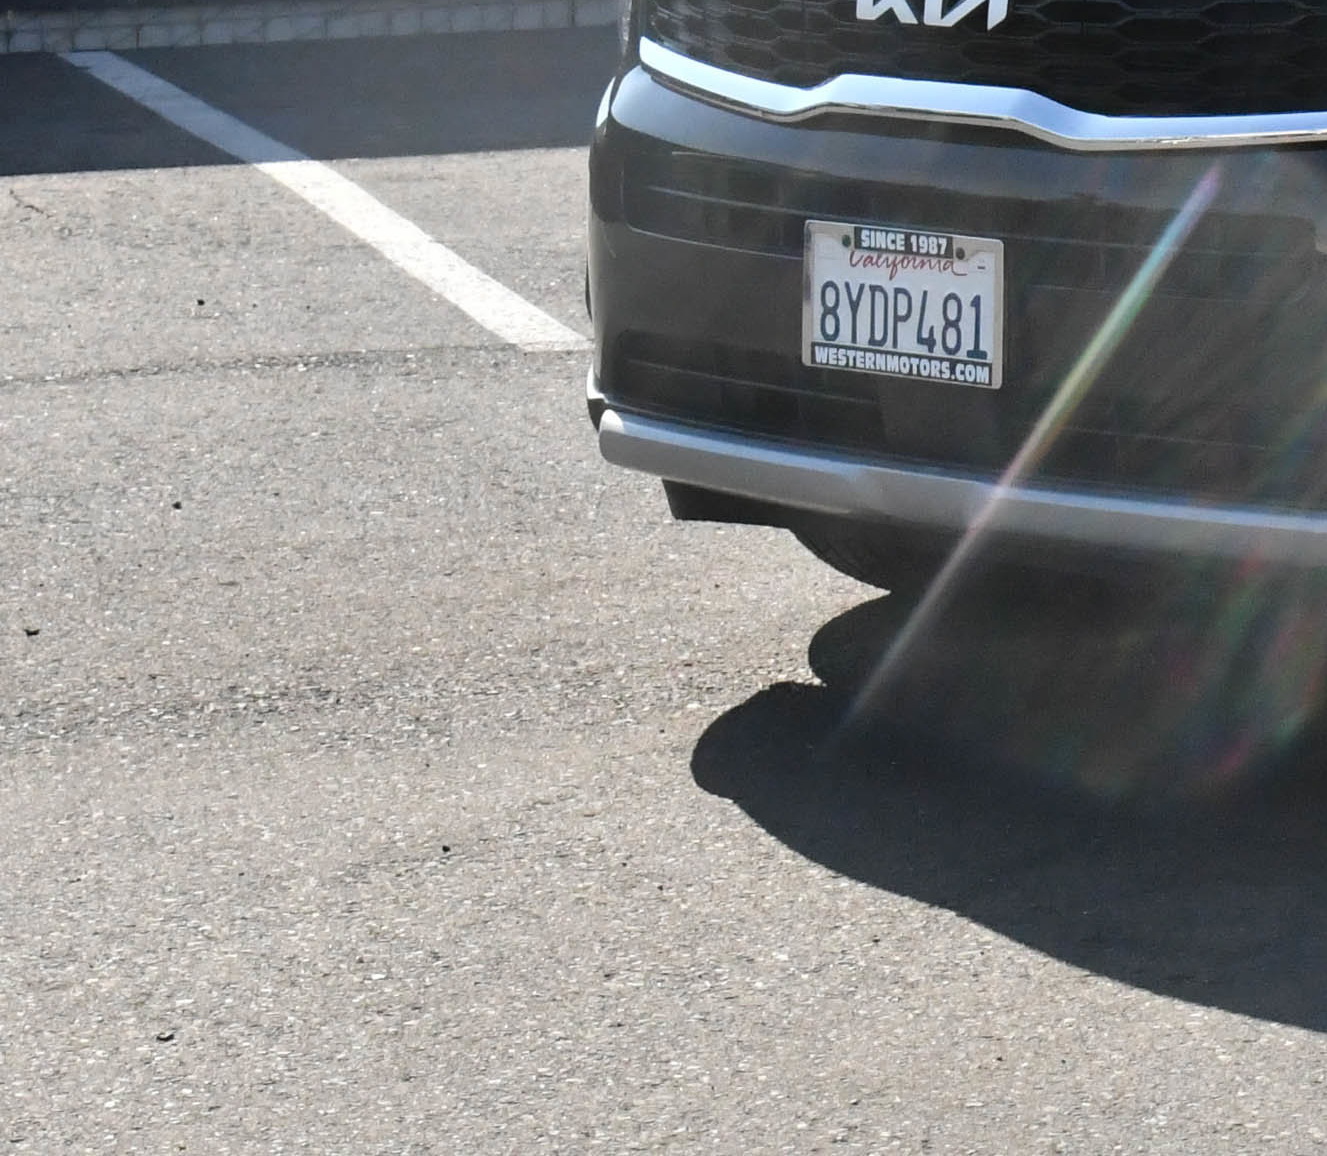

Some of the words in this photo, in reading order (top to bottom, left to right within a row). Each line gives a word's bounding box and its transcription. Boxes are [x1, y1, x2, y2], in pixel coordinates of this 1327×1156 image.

[860, 229, 905, 251] SINCE
[910, 235, 948, 255] 1987
[849, 250, 968, 281] California
[820, 280, 988, 359] 8YDP481
[815, 345, 990, 384] WESTERNMOTORS.COM
